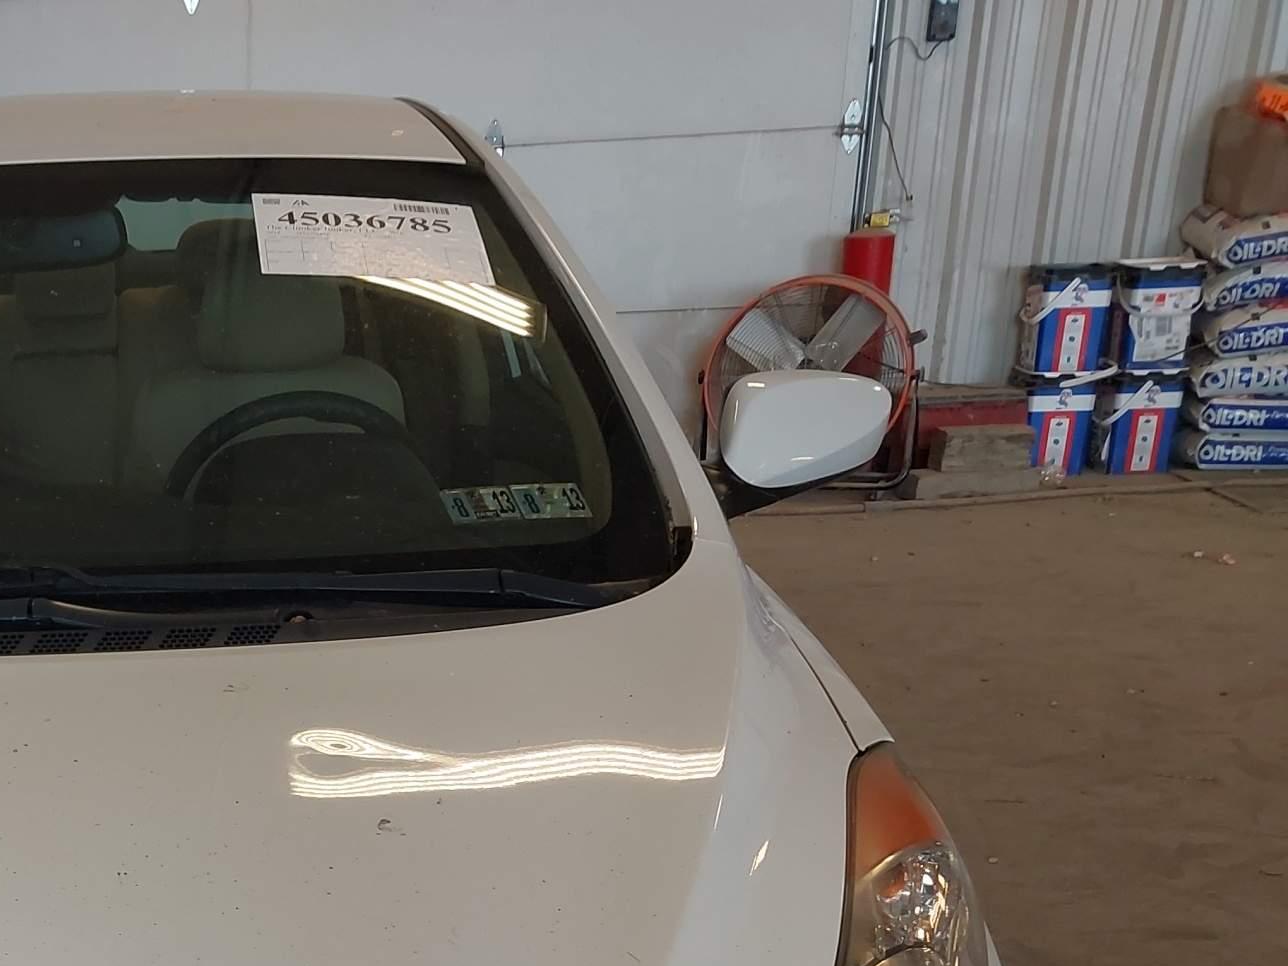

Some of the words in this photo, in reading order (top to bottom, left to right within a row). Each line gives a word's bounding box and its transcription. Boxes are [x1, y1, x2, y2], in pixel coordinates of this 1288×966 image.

[278, 211, 452, 234] 45036785
[492, 490, 516, 514] 13
[562, 487, 586, 511] 13
